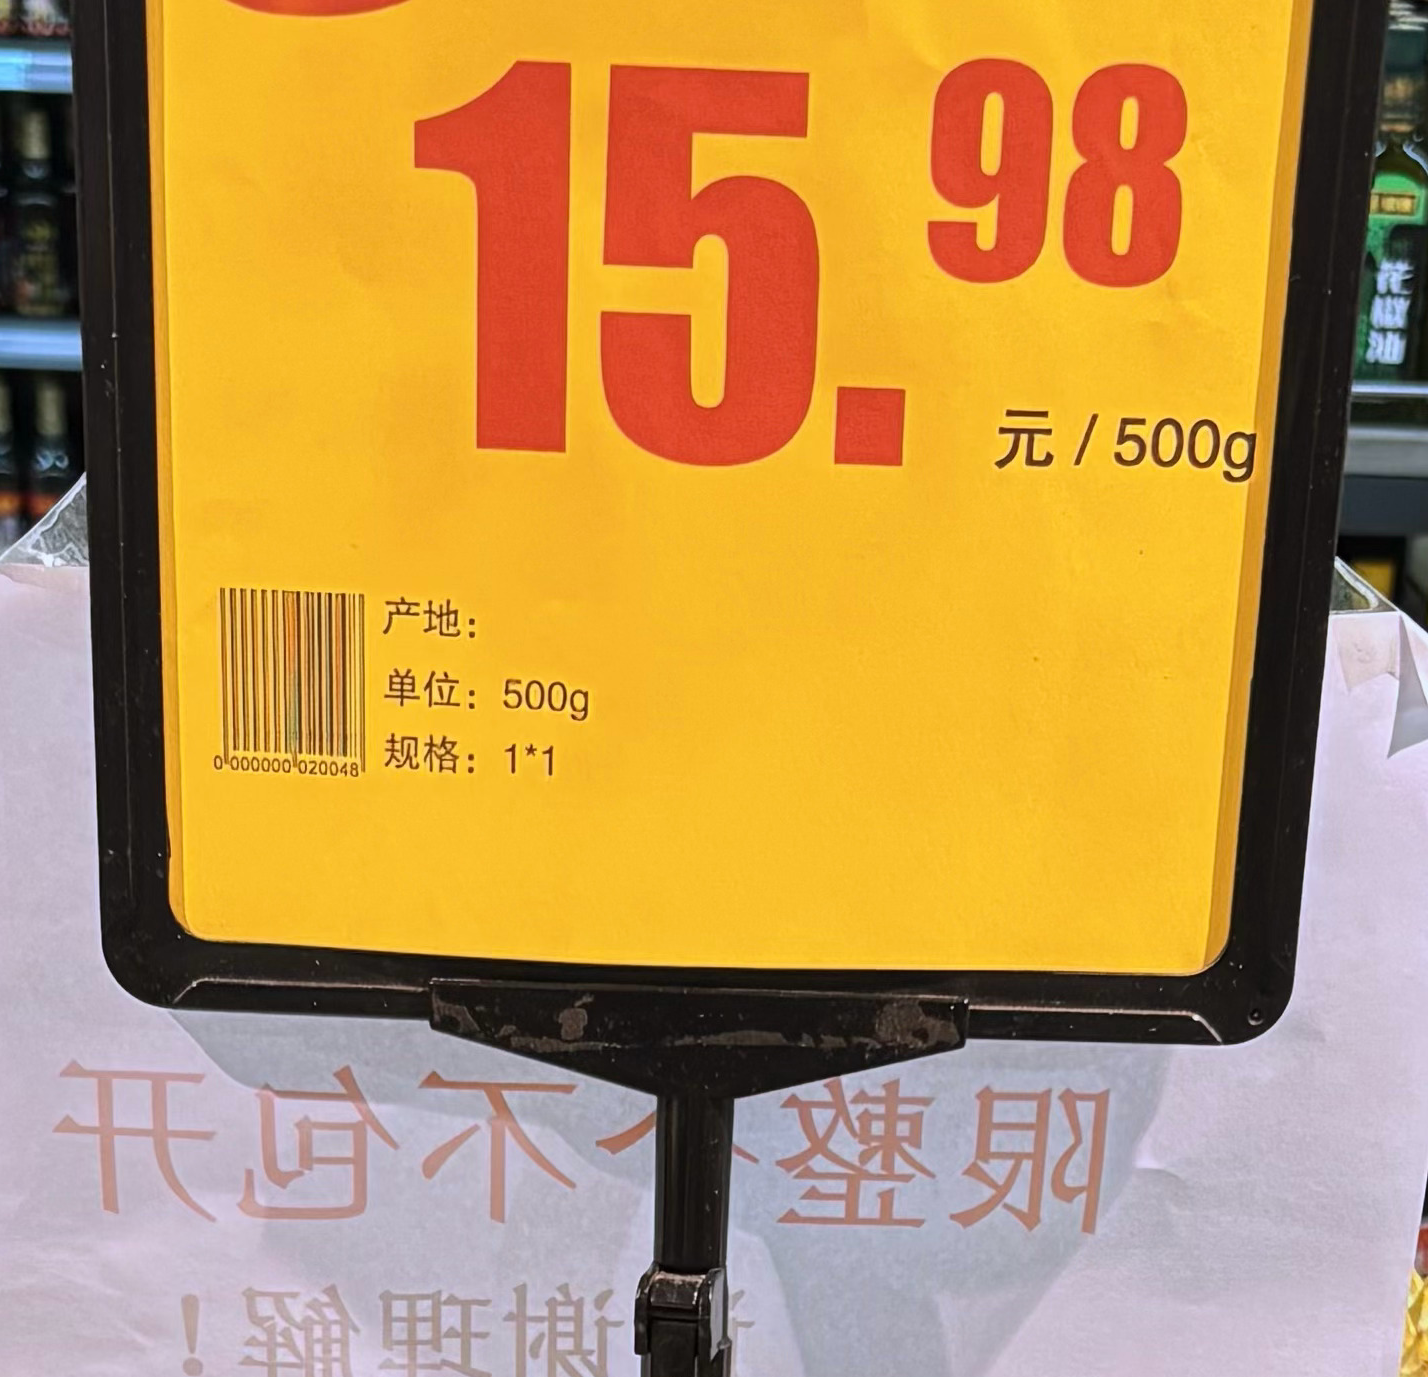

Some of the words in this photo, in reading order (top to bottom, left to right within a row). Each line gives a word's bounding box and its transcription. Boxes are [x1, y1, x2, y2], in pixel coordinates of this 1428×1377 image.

[928, 58, 1188, 288] 98
[994, 409, 1055, 469] 元
[1114, 417, 1257, 483] 500g
[382, 596, 477, 640] 产地：
[383, 668, 476, 710] 单位：
[502, 678, 590, 722] 500g
[383, 733, 476, 775] 规格：
